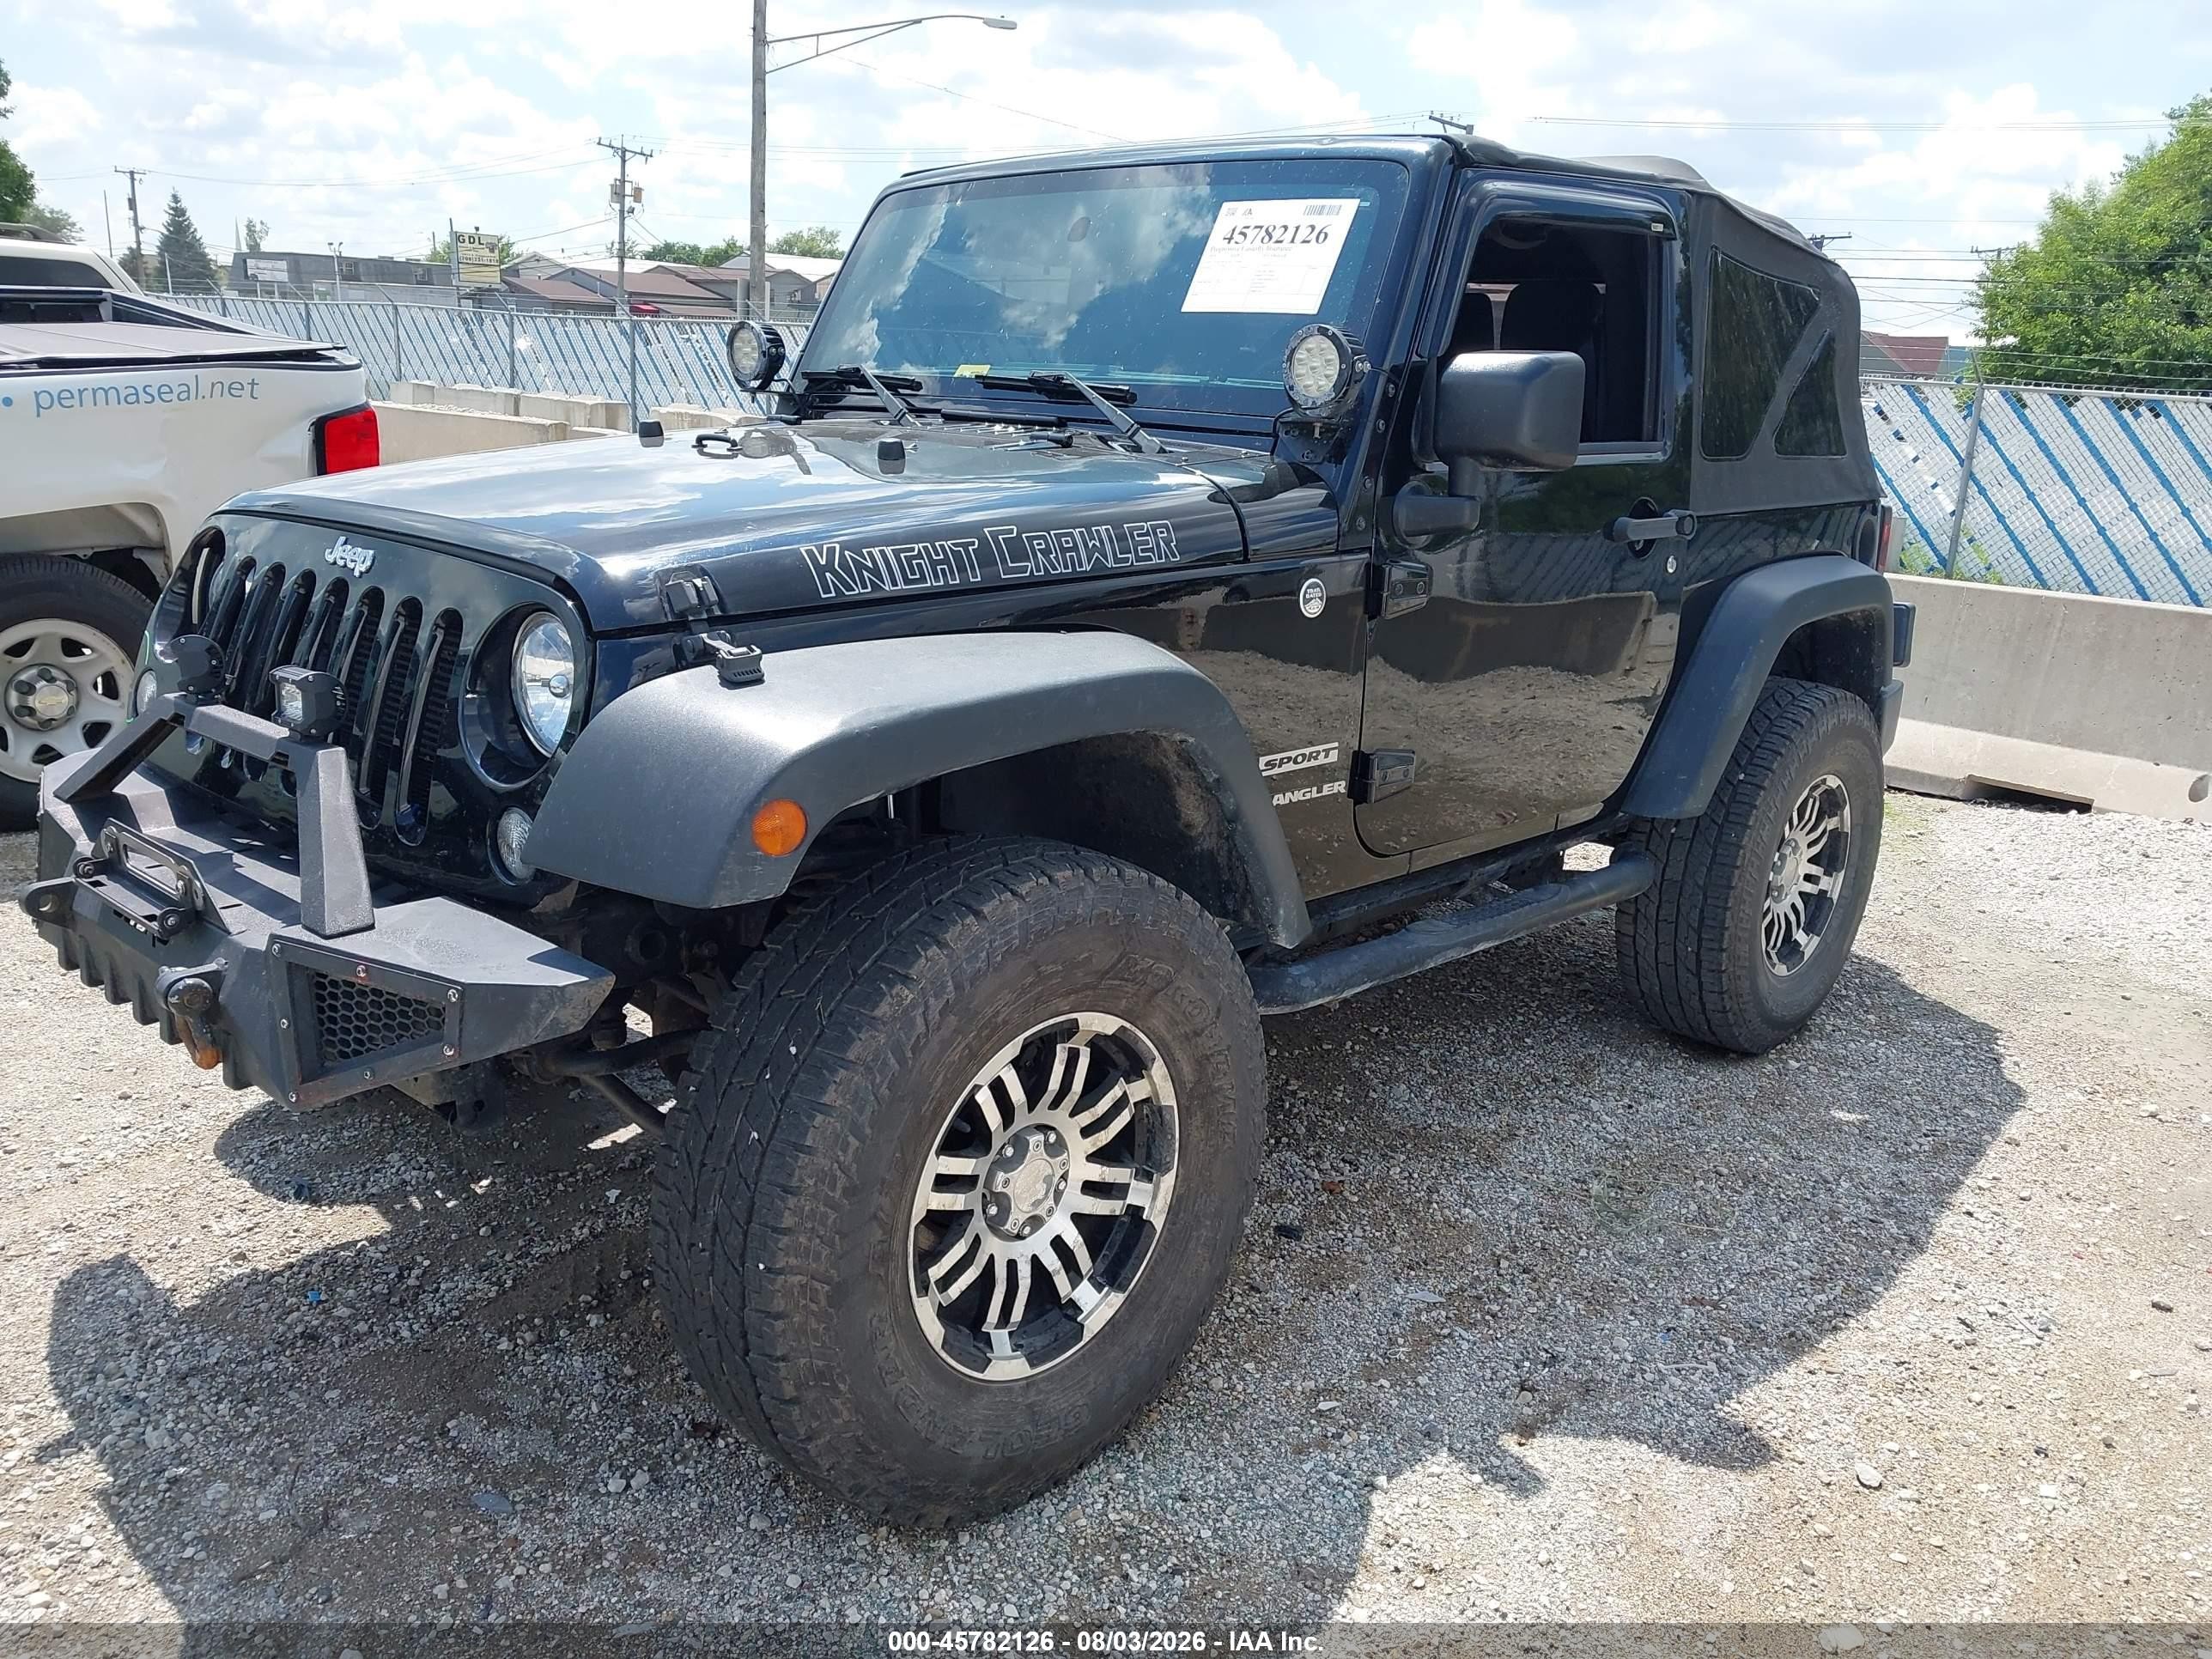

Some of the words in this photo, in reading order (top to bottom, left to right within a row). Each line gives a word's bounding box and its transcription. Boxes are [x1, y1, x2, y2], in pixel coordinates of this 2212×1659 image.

[1223, 224, 1332, 245] 45782126
[33, 374, 260, 417] permaseal.net
[325, 536, 375, 578] Jeep
[799, 538, 981, 599] KNIGHT
[983, 520, 1181, 580] CRAWLER
[1261, 747, 1338, 772] SPORT
[1273, 781, 1346, 805] ANGLER
